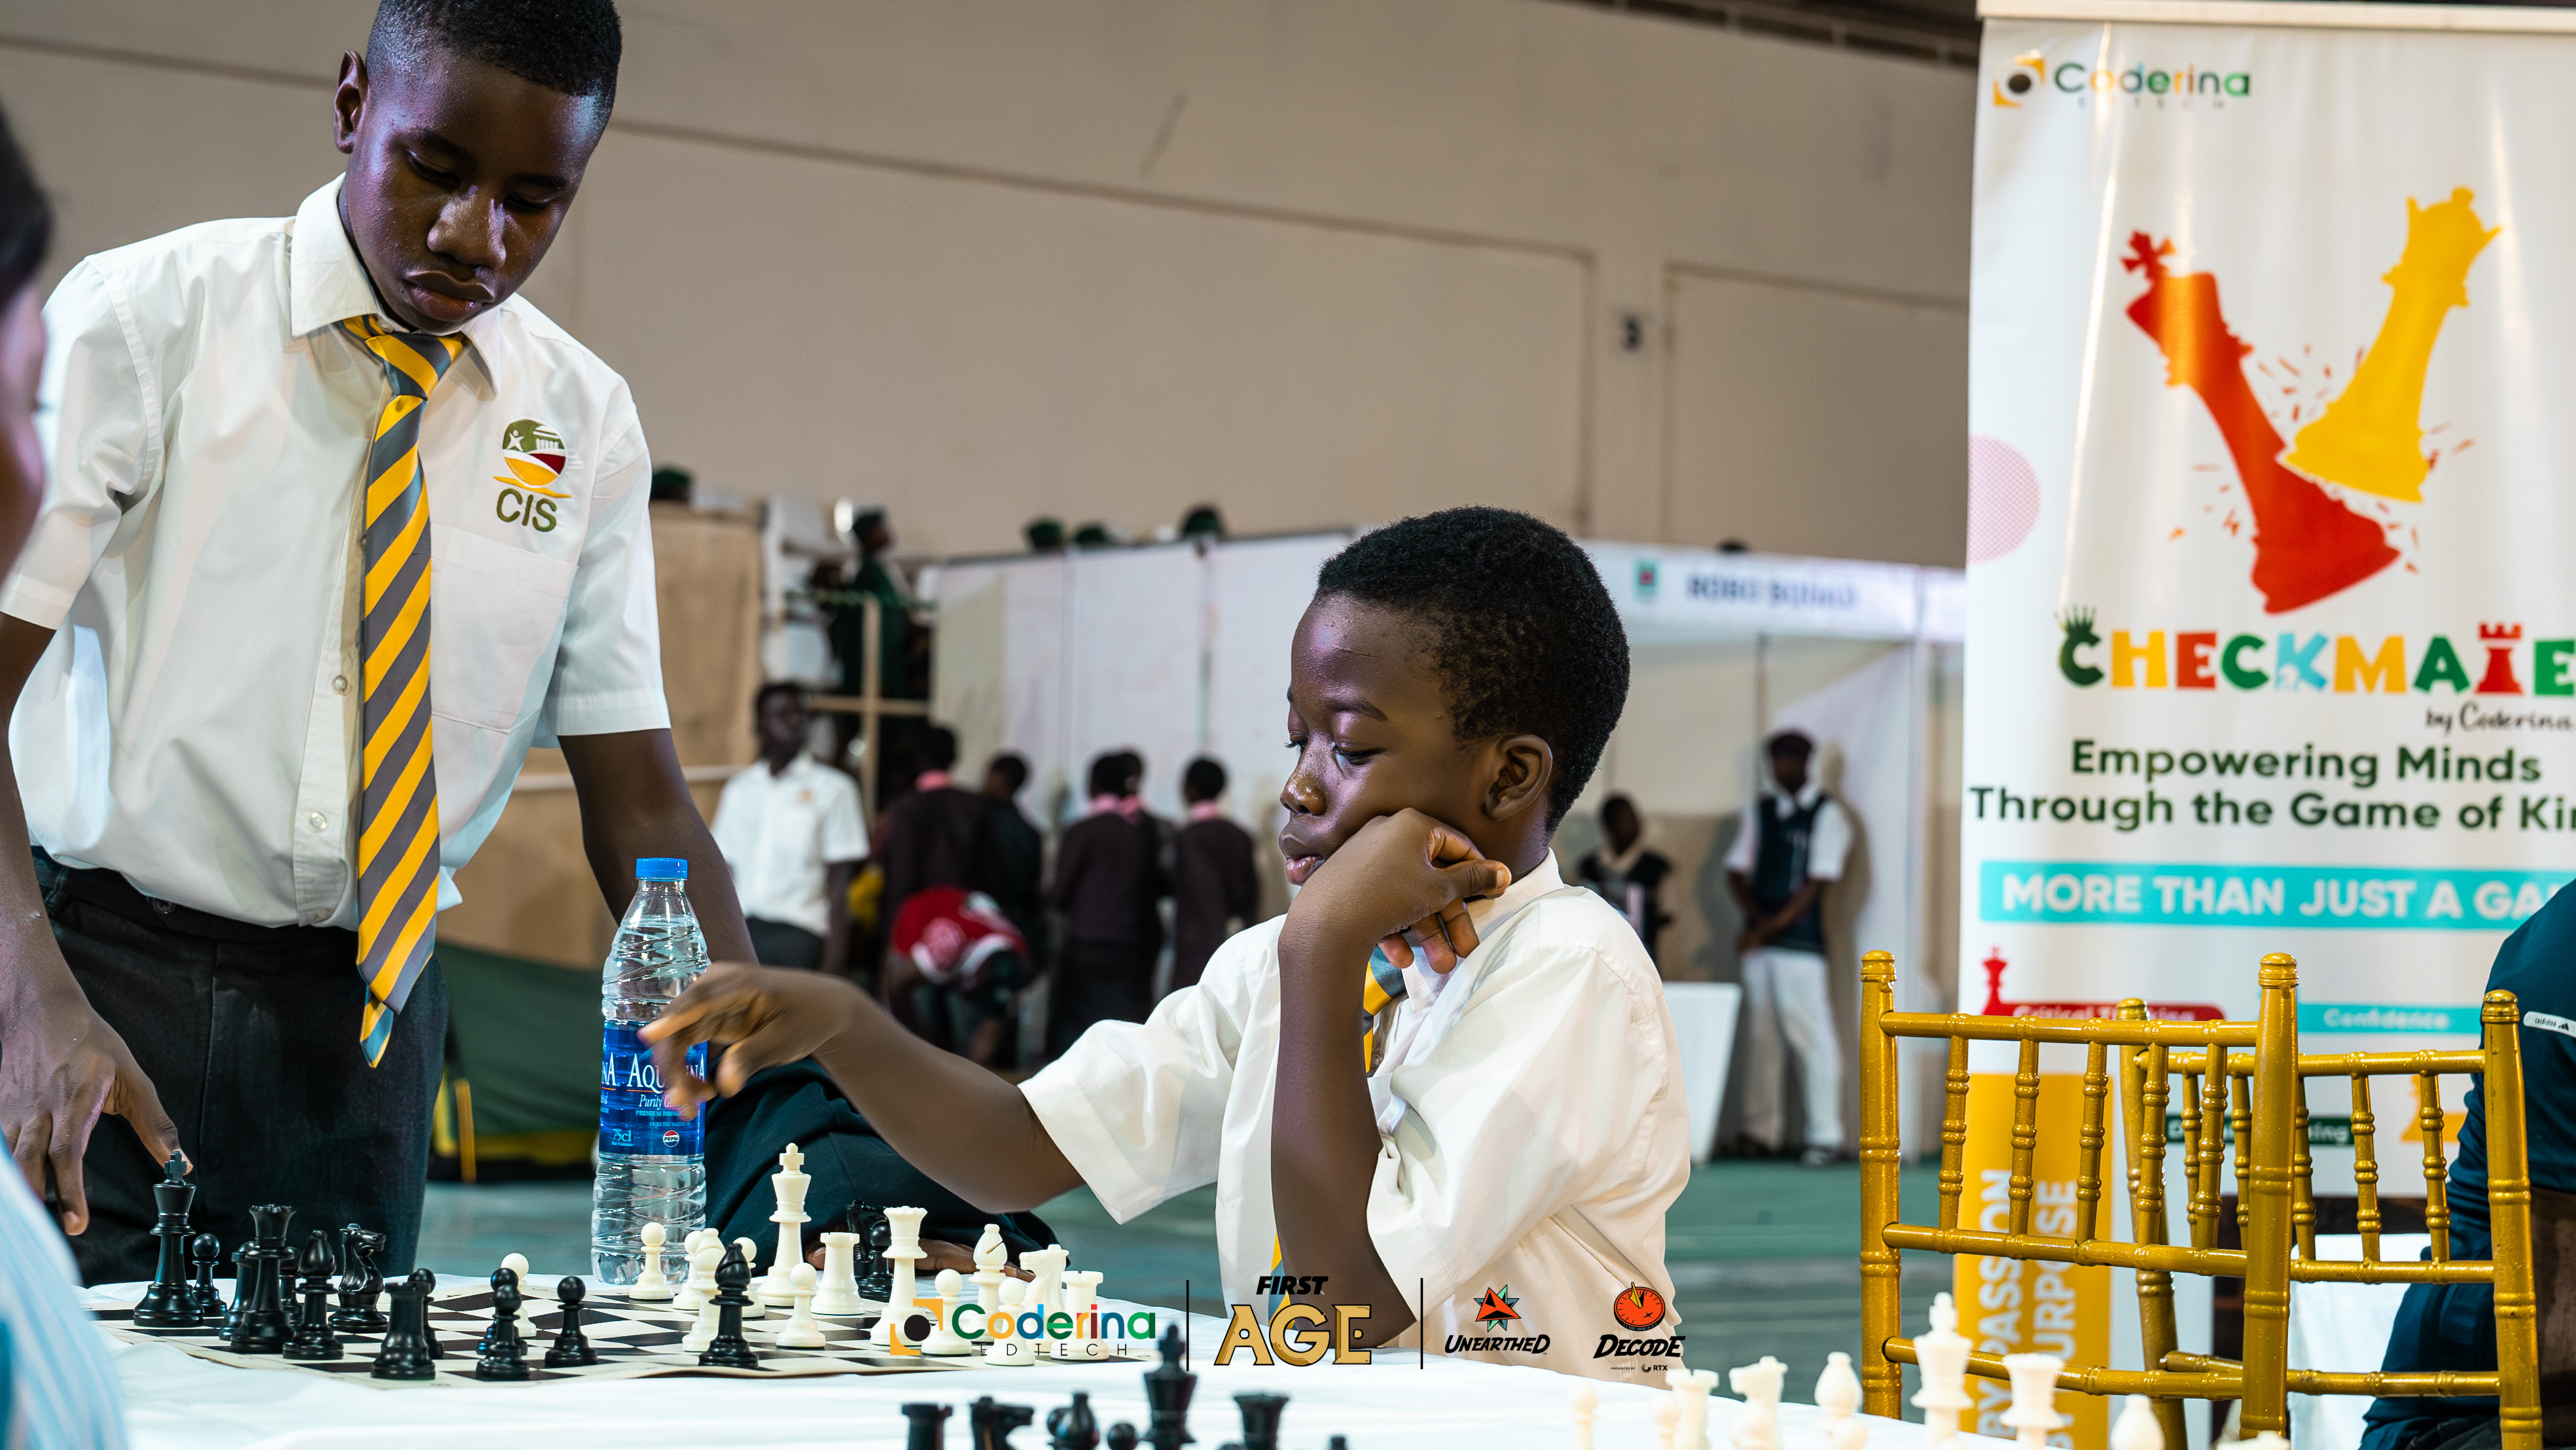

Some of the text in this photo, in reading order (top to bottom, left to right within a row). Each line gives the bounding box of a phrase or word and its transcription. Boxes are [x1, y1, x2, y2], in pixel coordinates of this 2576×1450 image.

[2054, 63, 2250, 96] Coderina
[497, 488, 557, 532] CIS
[2058, 618, 2575, 698] CHECKMATE
[2425, 707, 2452, 736] by
[2072, 740, 2541, 788] Empowering Minds
[1970, 787, 2576, 832] Through the Game of Ki
[2002, 873, 2563, 921] MORE THAN JUST A GA
[639, 1094, 663, 1110] Purity
[1978, 1169, 2022, 1356] PASSON
